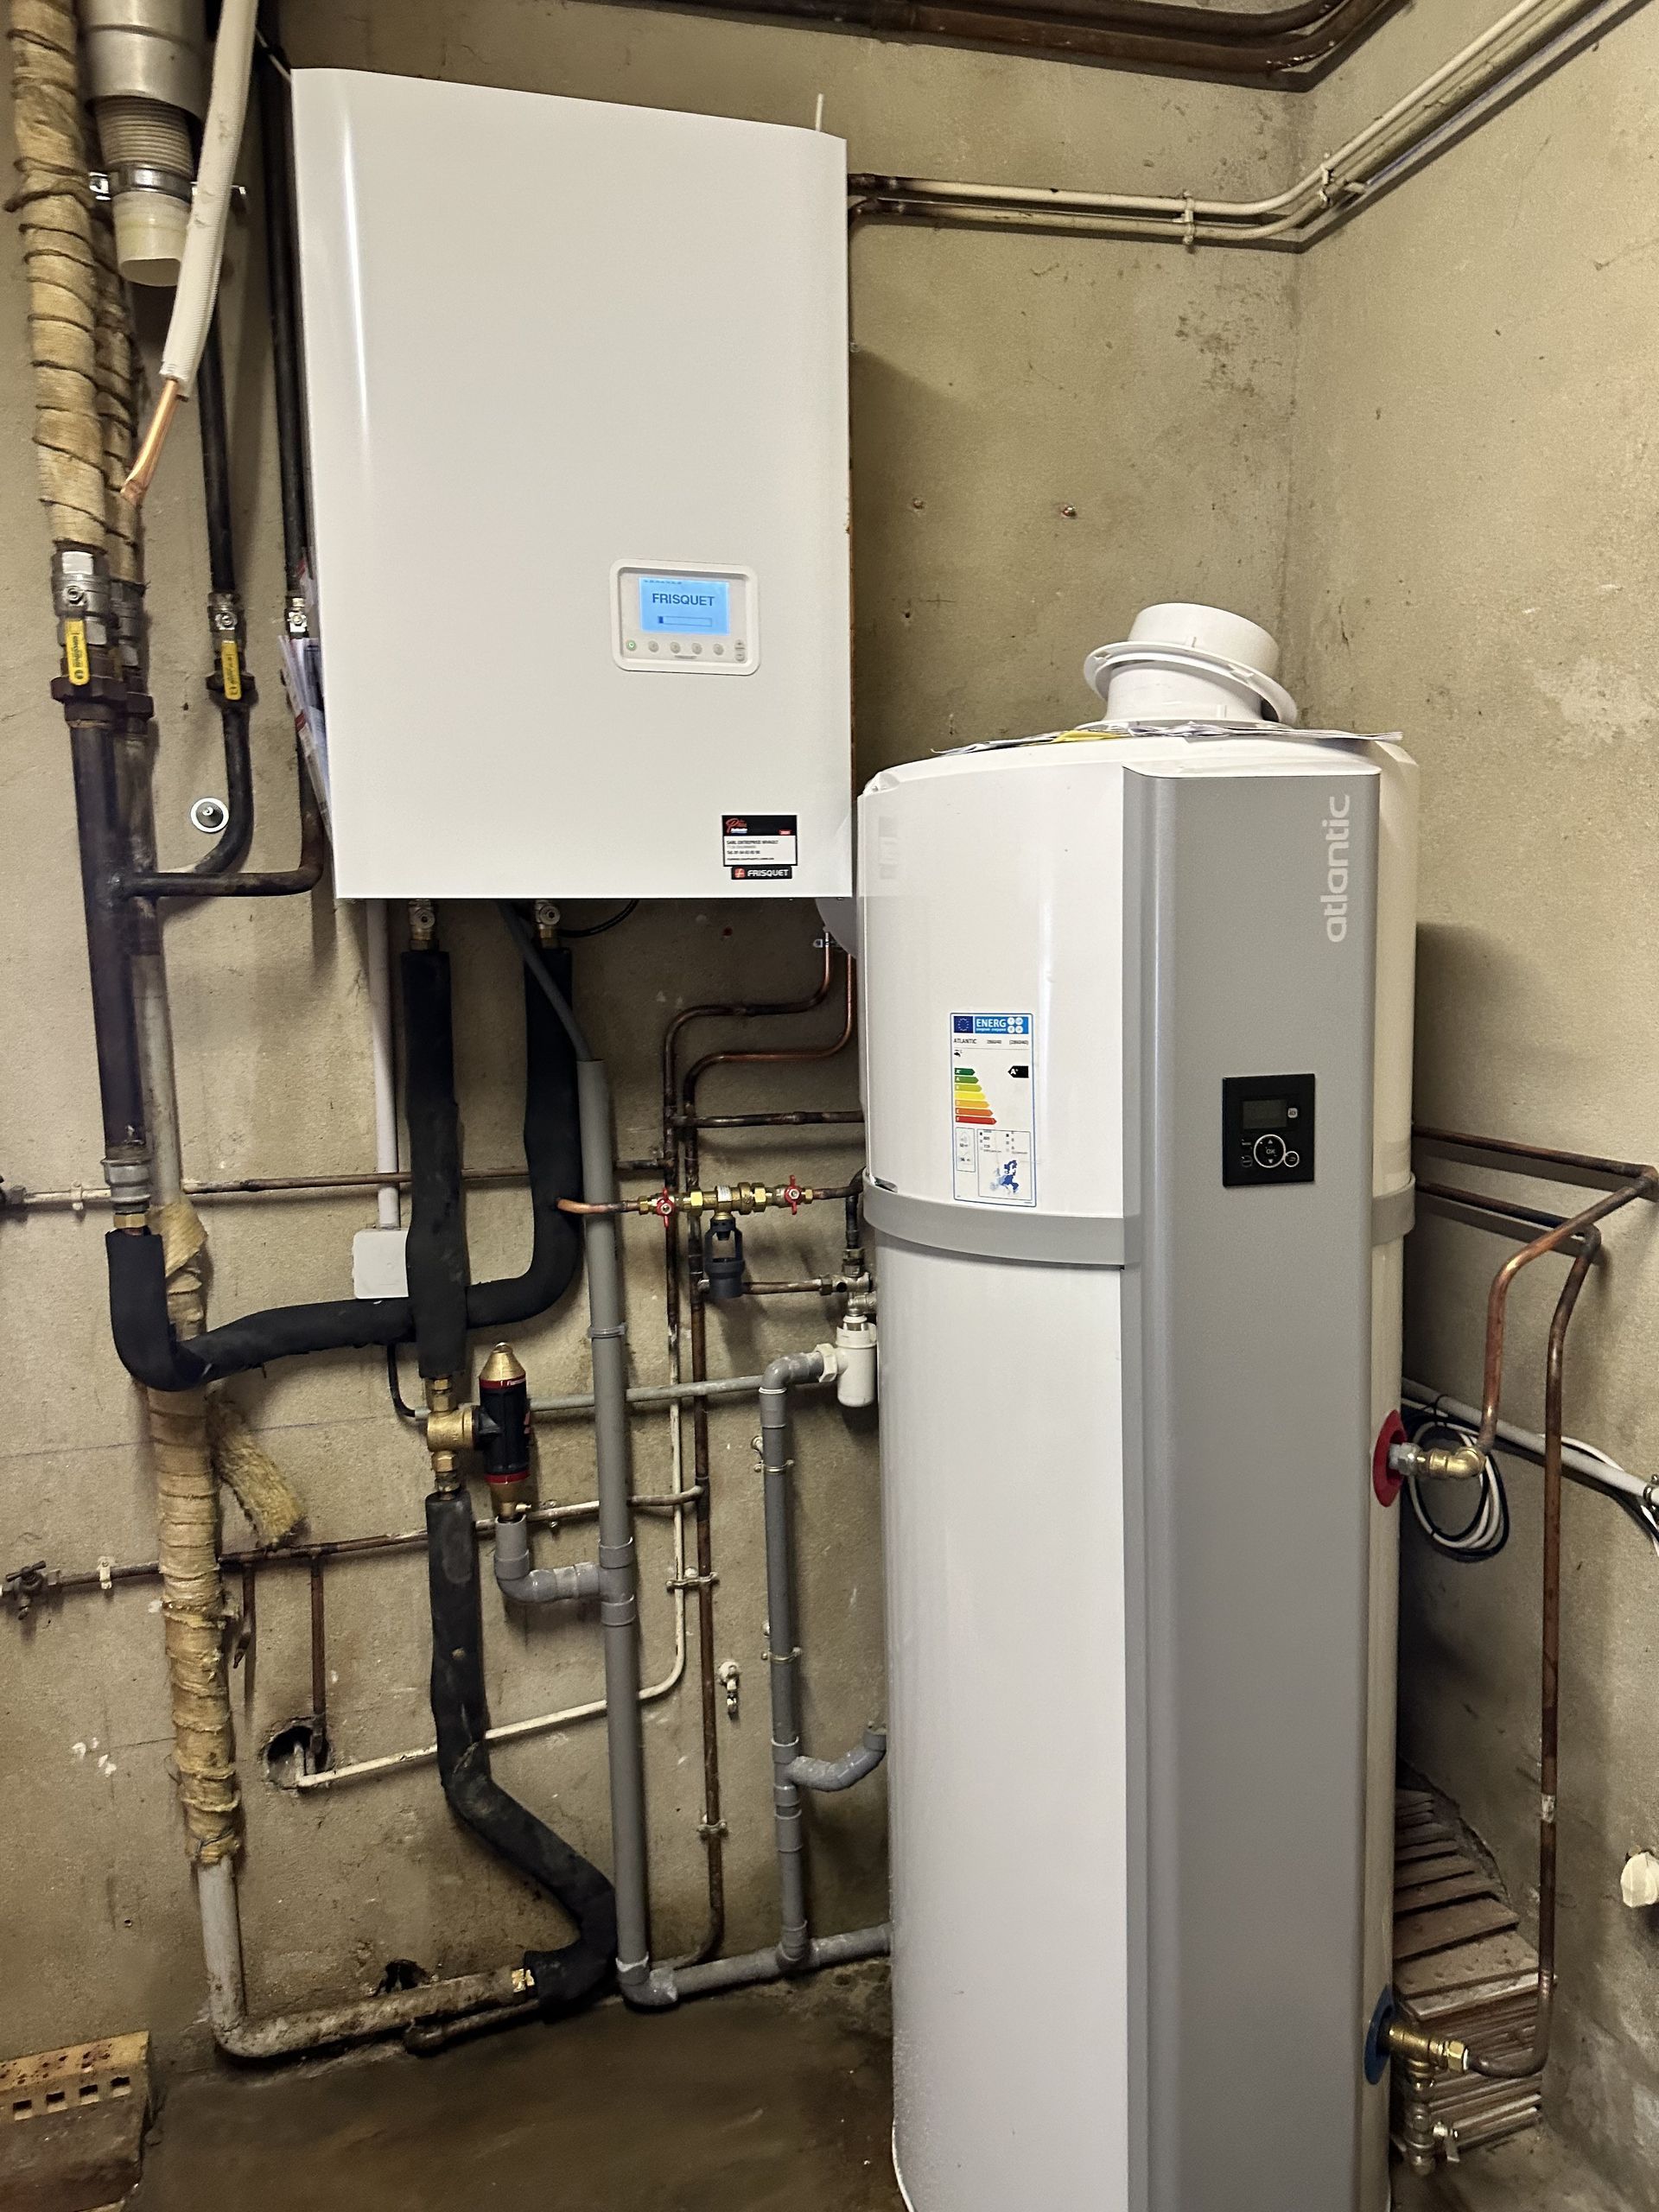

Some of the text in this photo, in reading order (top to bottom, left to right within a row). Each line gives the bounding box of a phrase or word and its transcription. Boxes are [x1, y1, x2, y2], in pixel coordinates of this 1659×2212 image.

[652, 593, 715, 607] FRISQUET
[1320, 794, 1351, 943] atlantic
[976, 1019, 1007, 1028] ENERG
